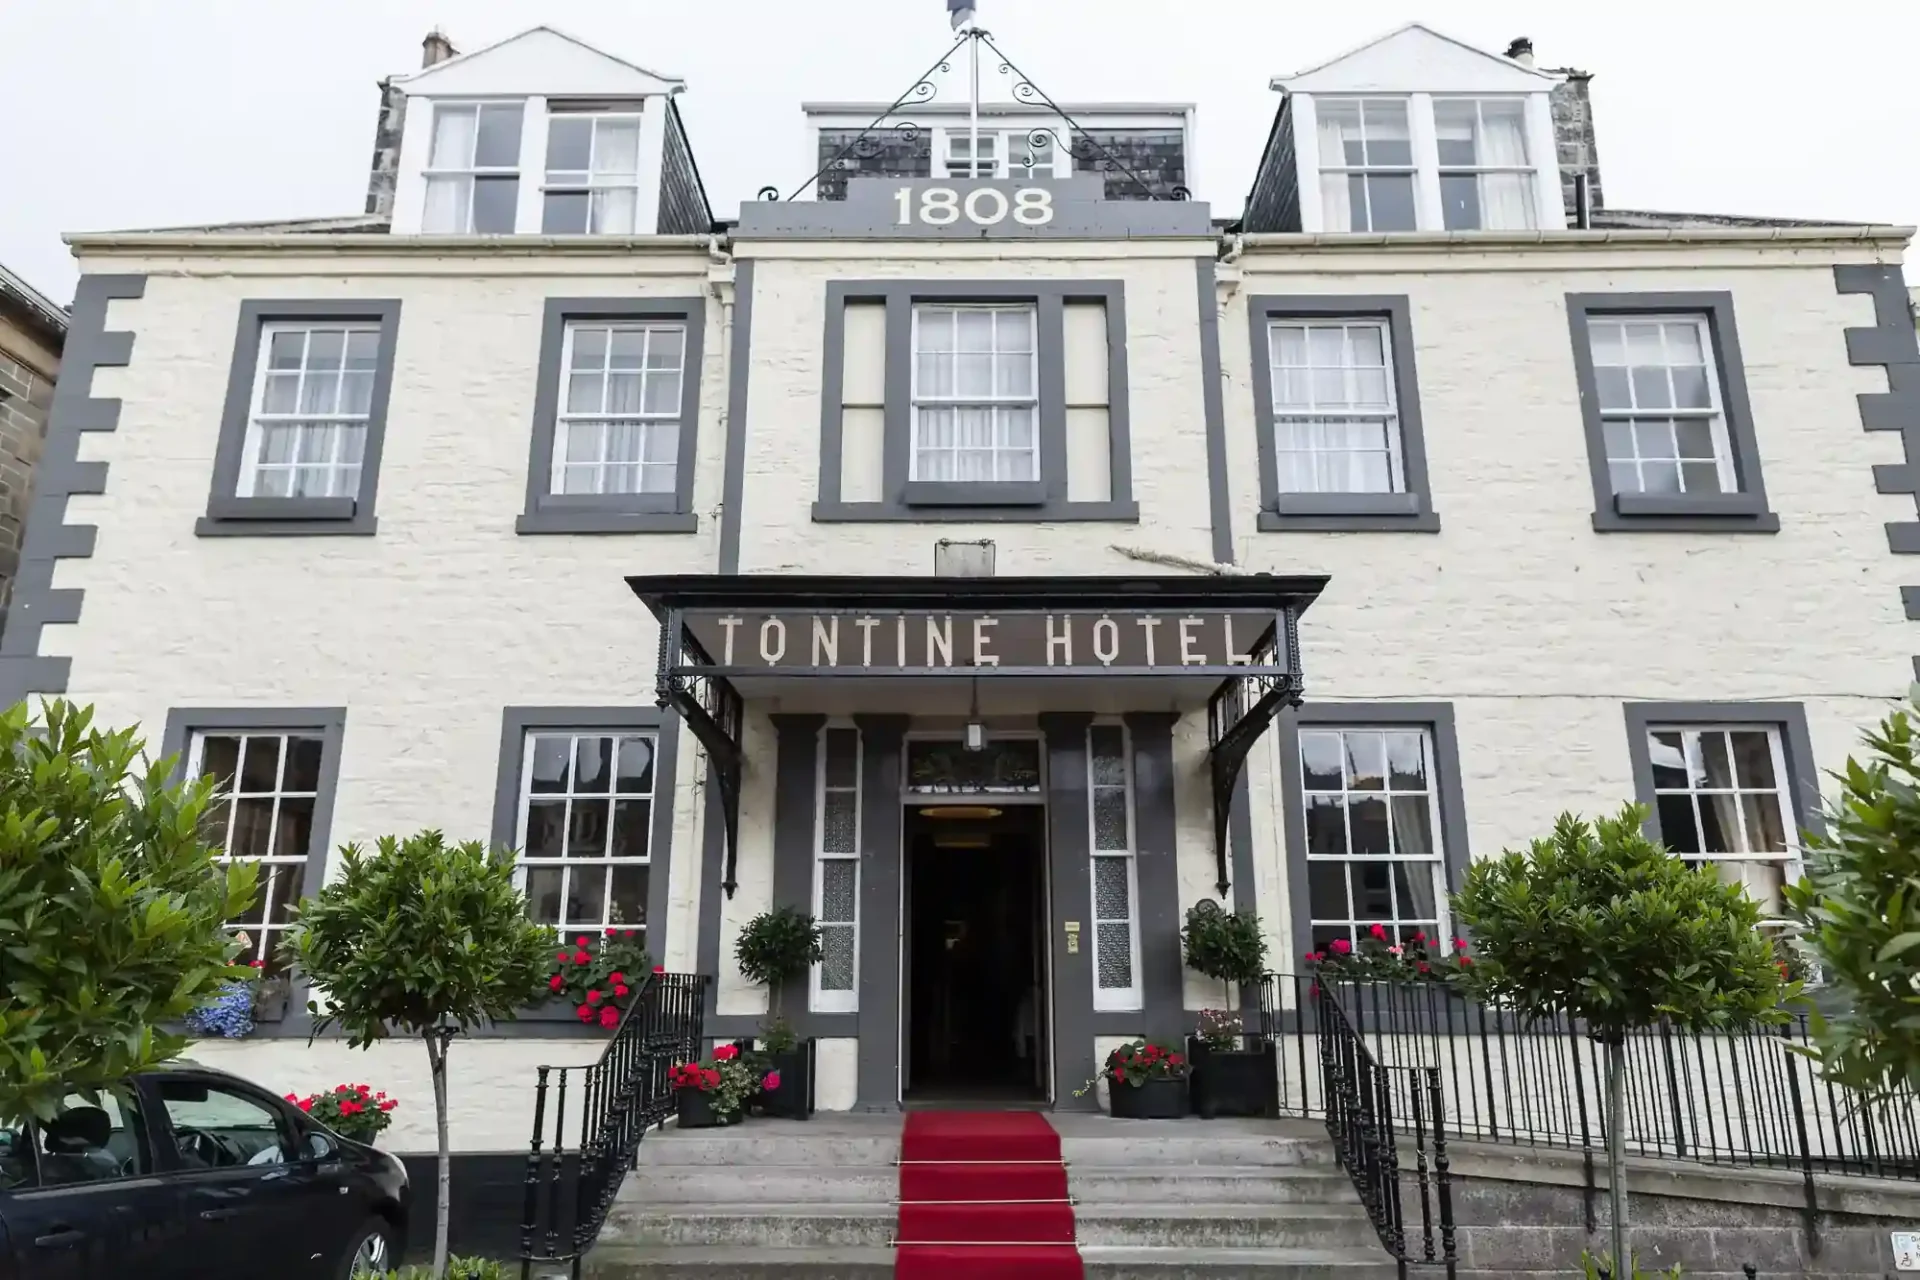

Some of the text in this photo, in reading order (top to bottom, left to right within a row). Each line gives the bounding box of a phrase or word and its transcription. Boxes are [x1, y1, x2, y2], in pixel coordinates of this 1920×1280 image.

[894, 187, 1054, 225] 1808
[718, 613, 1252, 667] TONTINE HOTEL
